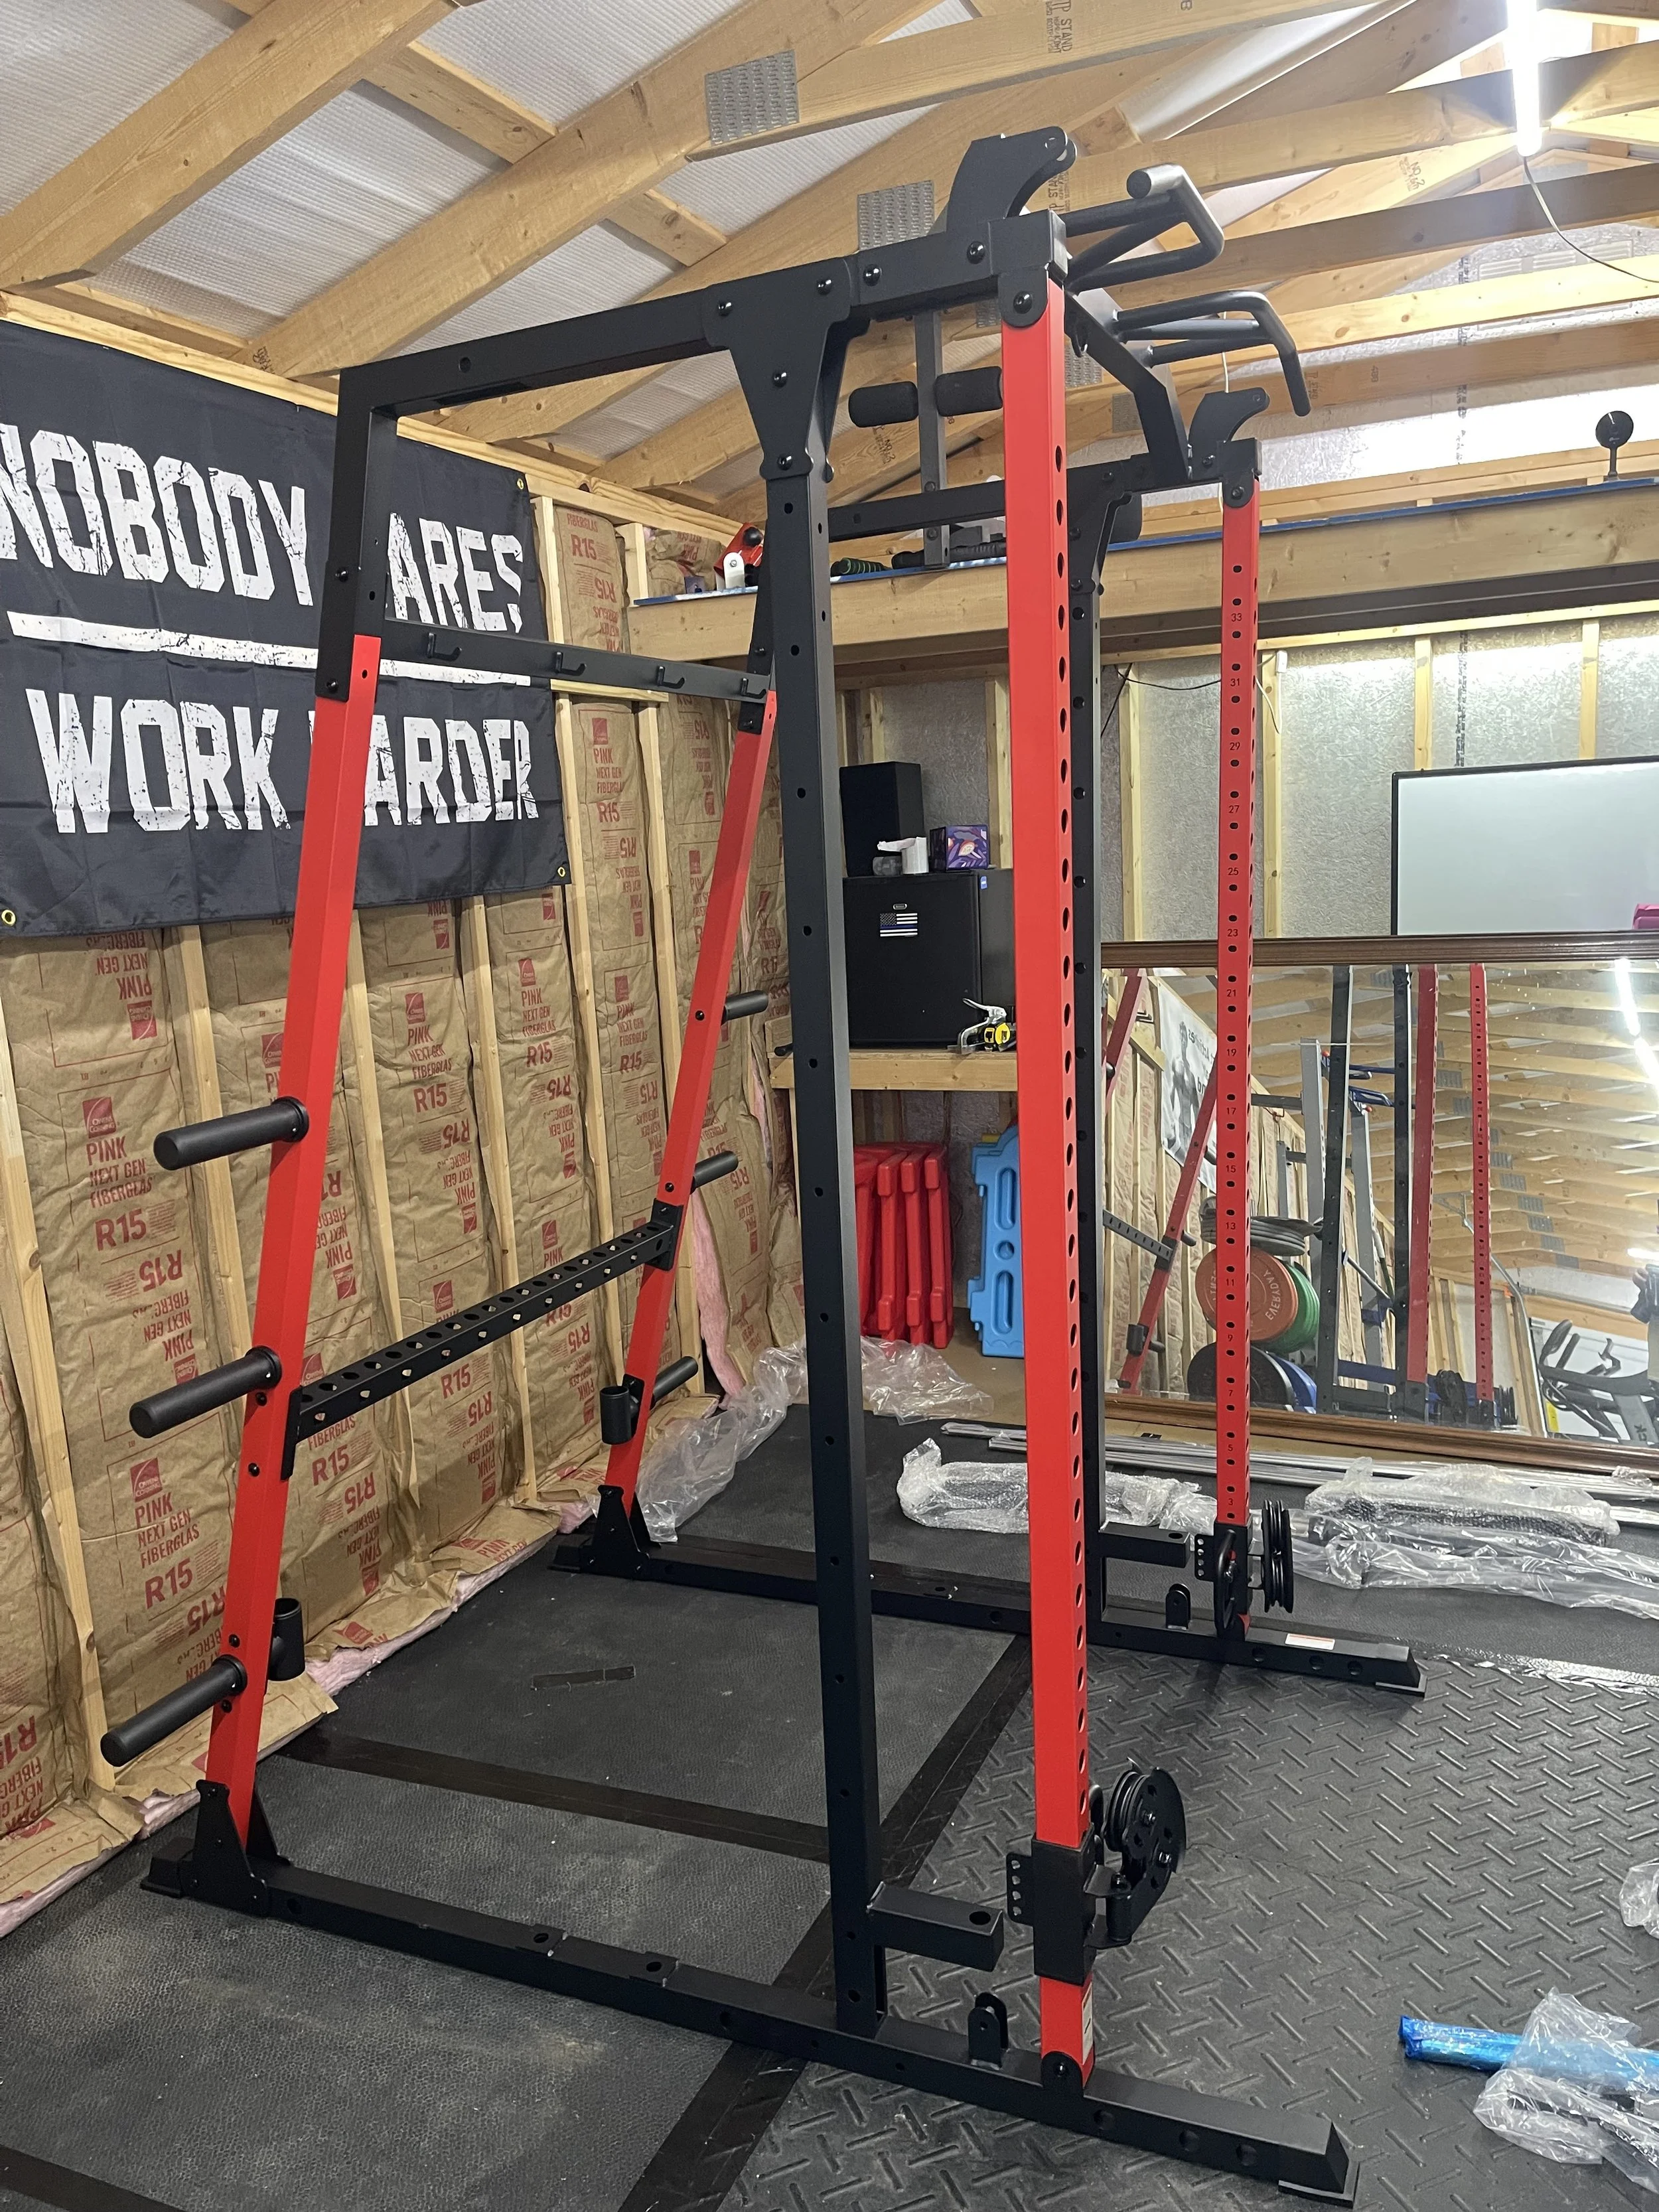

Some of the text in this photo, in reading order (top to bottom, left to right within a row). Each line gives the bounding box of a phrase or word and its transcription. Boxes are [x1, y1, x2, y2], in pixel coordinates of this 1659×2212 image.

[0, 423, 524, 633] NOBODY ARES
[571, 534, 597, 560] R15
[595, 577, 617, 603] R15
[1231, 613, 1242, 623] 33
[593, 747, 614, 764] PINK
[1230, 742, 1240, 751] 29
[25, 688, 539, 834] WORK ARDER
[597, 802, 620, 823] R15
[1228, 804, 1240, 814] 27
[620, 836, 636, 858] R15
[1228, 867, 1239, 875] 25
[1227, 928, 1238, 937] 23
[96, 953, 148, 975] NEXT GEN
[116, 975, 152, 1000] PINK
[521, 987, 542, 1007] PINK
[1226, 989, 1236, 997] 21
[522, 1005, 551, 1023] NEXT GEN
[407, 1025, 433, 1045] PINK
[522, 1019, 556, 1038] FIBERGLAS
[408, 1047, 430, 1063] NEXT
[526, 1041, 553, 1068] R15
[620, 1051, 642, 1074] R15
[413, 1058, 452, 1080] FIBERGLAS
[413, 1082, 448, 1114] R15
[547, 1074, 572, 1100] R15
[640, 1080, 658, 1104] R15
[443, 1118, 470, 1149] R15
[559, 1132, 575, 1153] PINK
[86, 1136, 127, 1165] PINK
[89, 1159, 146, 1187] NEXT GEN
[443, 1166, 473, 1190] NEXT GEN
[731, 1167, 750, 1191] R15
[90, 1177, 153, 1209] FIBERGLAS
[456, 1181, 475, 1206] PINK
[95, 1209, 147, 1252] R15
[316, 1226, 348, 1249] NEXT GE
[326, 1241, 353, 1269] PINK
[543, 1246, 564, 1270] PINK
[139, 1249, 182, 1293] R15
[143, 1309, 191, 1343] NEXT GEN
[568, 1323, 591, 1355] R15
[161, 1329, 194, 1361] PINK
[441, 1363, 471, 1400] R15
[577, 1378, 595, 1401] PINK
[468, 1390, 492, 1427] R15
[307, 1415, 356, 1450] FIBERGLAS
[311, 1443, 350, 1487] R15
[477, 1455, 496, 1479] PINK
[344, 1471, 376, 1514] R15
[135, 1492, 173, 1528] PINK
[137, 1507, 192, 1550] NEXT GEN
[139, 1524, 200, 1570] FIBERGLAS
[359, 1544, 382, 1570] PINK
[145, 1557, 193, 1610] R15
[186, 1585, 226, 1637] R15
[0, 1715, 37, 1769] R1
[15, 1777, 44, 1808] NEXT
